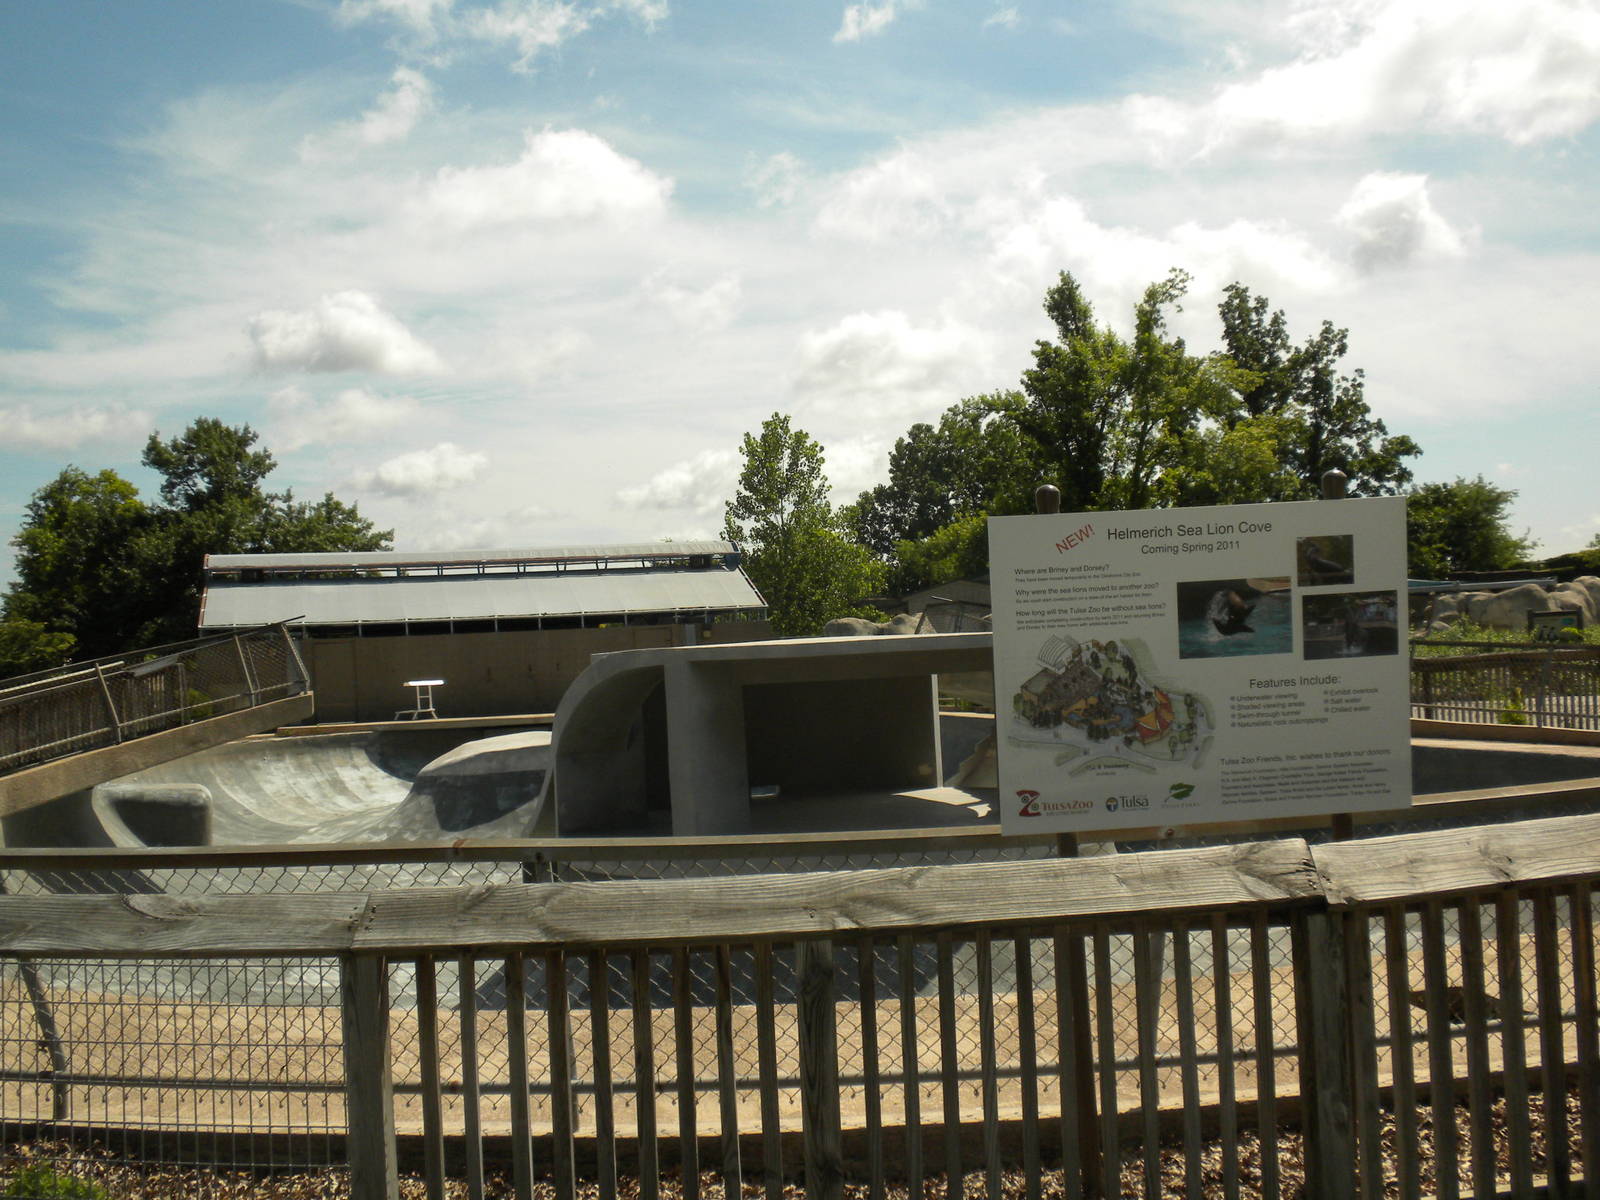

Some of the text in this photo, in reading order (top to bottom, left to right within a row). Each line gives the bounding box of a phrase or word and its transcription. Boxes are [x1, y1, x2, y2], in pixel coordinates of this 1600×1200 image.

[1107, 521, 1272, 540] Helmerich Sea Lion Cove
[1055, 523, 1096, 554] NEW!
[1141, 540, 1240, 555] Coming Spring 2011
[1014, 567, 1036, 575] Where
[1015, 588, 1030, 598] Why
[1072, 585, 1088, 593] lions
[1089, 584, 1110, 593] moved
[1119, 582, 1142, 591] another
[1016, 609, 1031, 617] How
[1031, 608, 1046, 618] long
[1069, 606, 1087, 614] Tulsa
[1088, 605, 1100, 613] Zoo
[1111, 603, 1134, 612] without
[1249, 677, 1297, 689] Features
[1119, 794, 1149, 809] Tulsa
